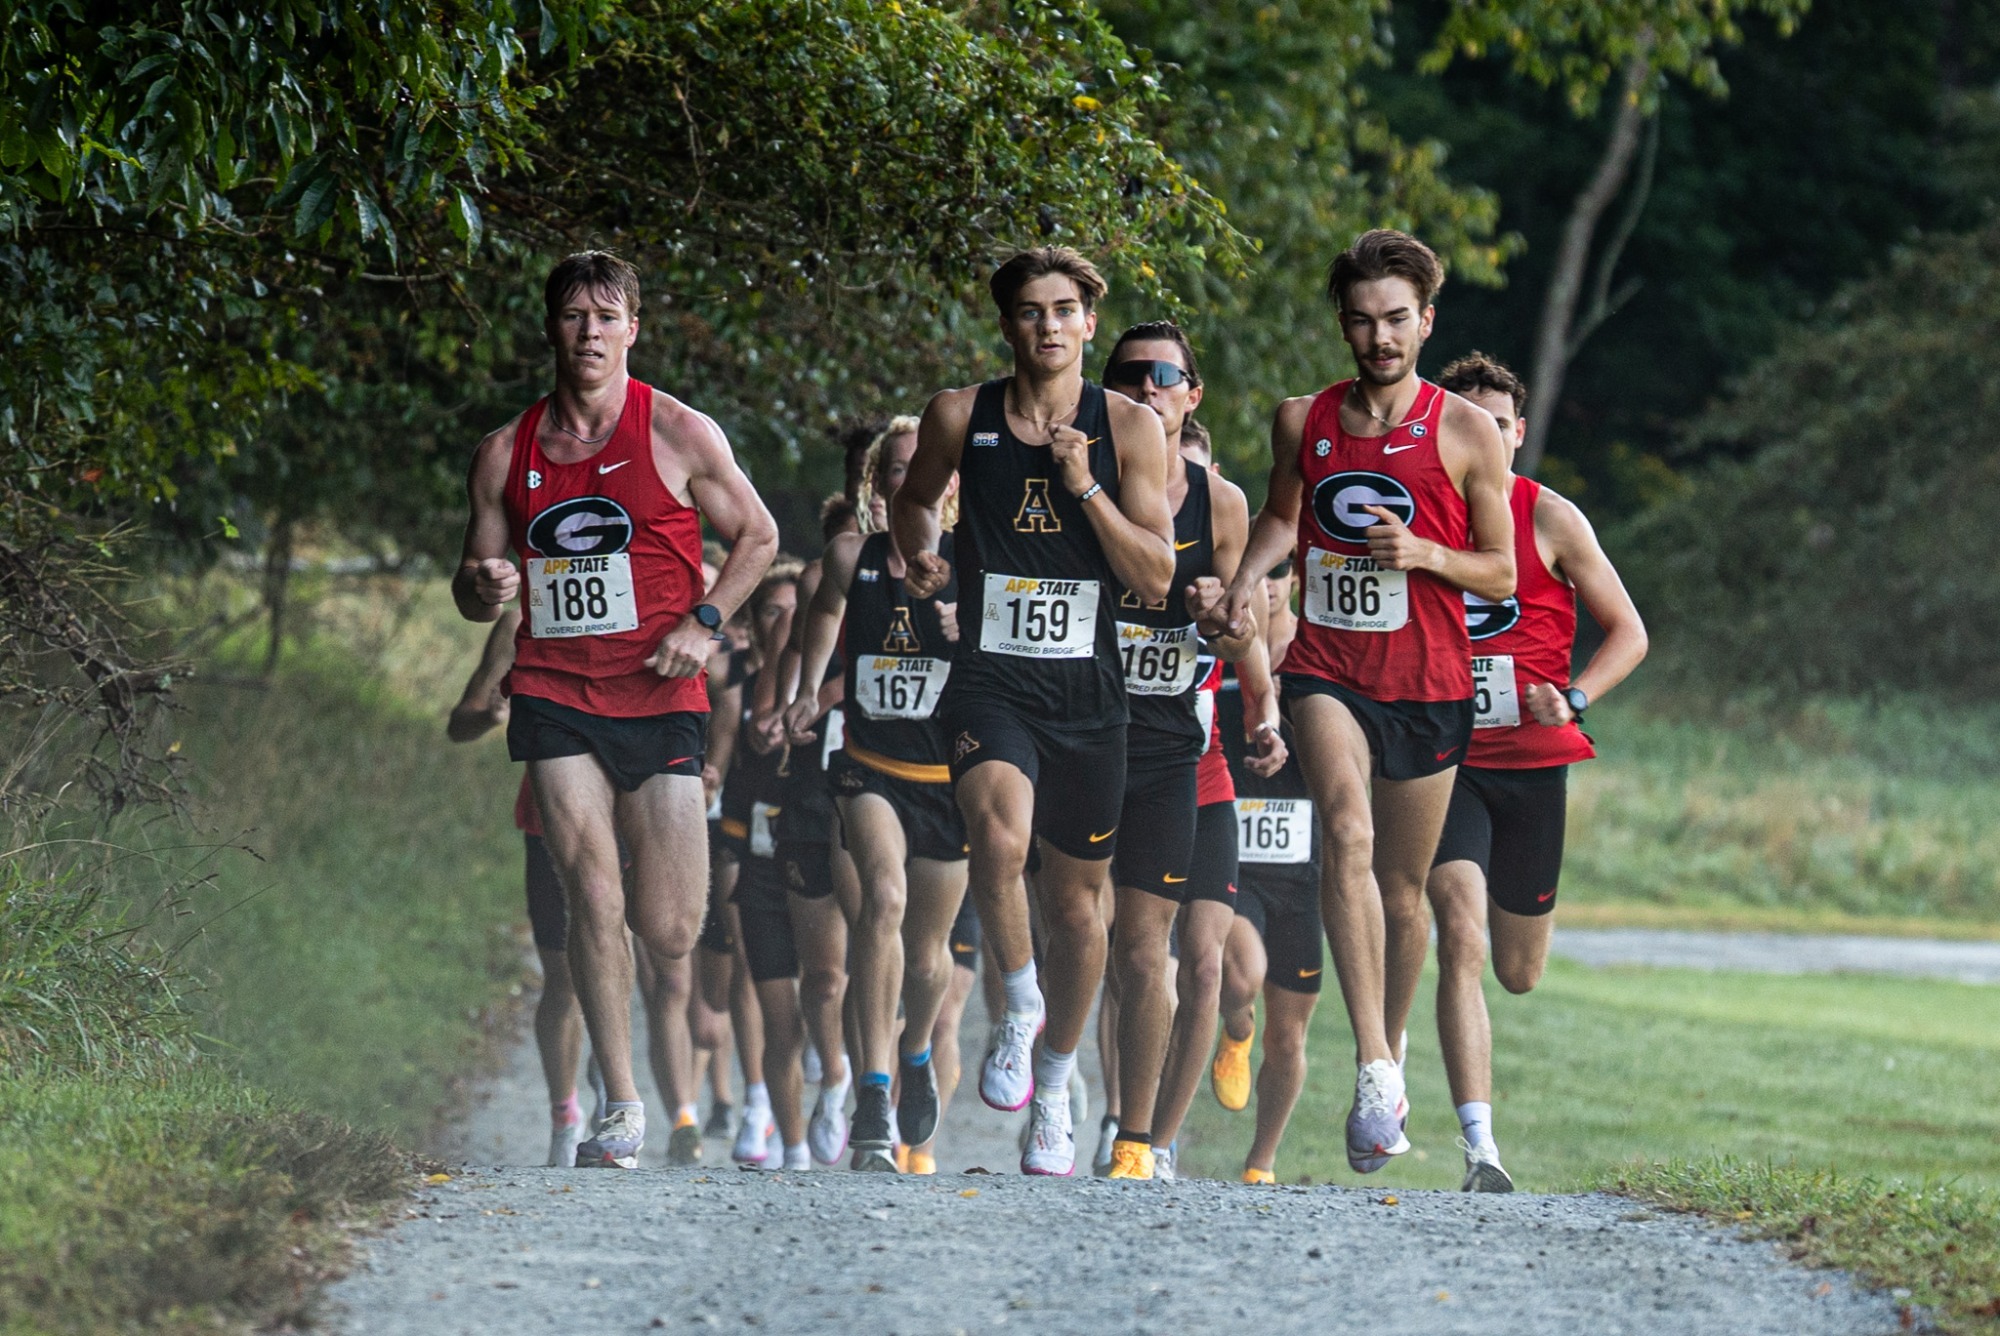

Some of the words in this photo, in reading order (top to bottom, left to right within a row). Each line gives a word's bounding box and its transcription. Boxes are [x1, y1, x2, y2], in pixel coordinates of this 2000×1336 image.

[1013, 478, 1062, 532] A
[1312, 470, 1415, 544] G
[527, 495, 633, 559] G
[546, 576, 608, 622] 188
[1322, 572, 1380, 616] 186
[545, 624, 583, 634] COVERED
[584, 622, 618, 633] BRIDGE
[1006, 597, 1070, 642] 159
[1318, 614, 1354, 628] COVERED
[1355, 620, 1389, 629] BRIDGE
[998, 642, 1041, 653] COVERED
[1042, 645, 1075, 655] BRIDGE
[1121, 643, 1180, 682] 169
[874, 673, 927, 711] 167
[1241, 816, 1289, 849] 165
